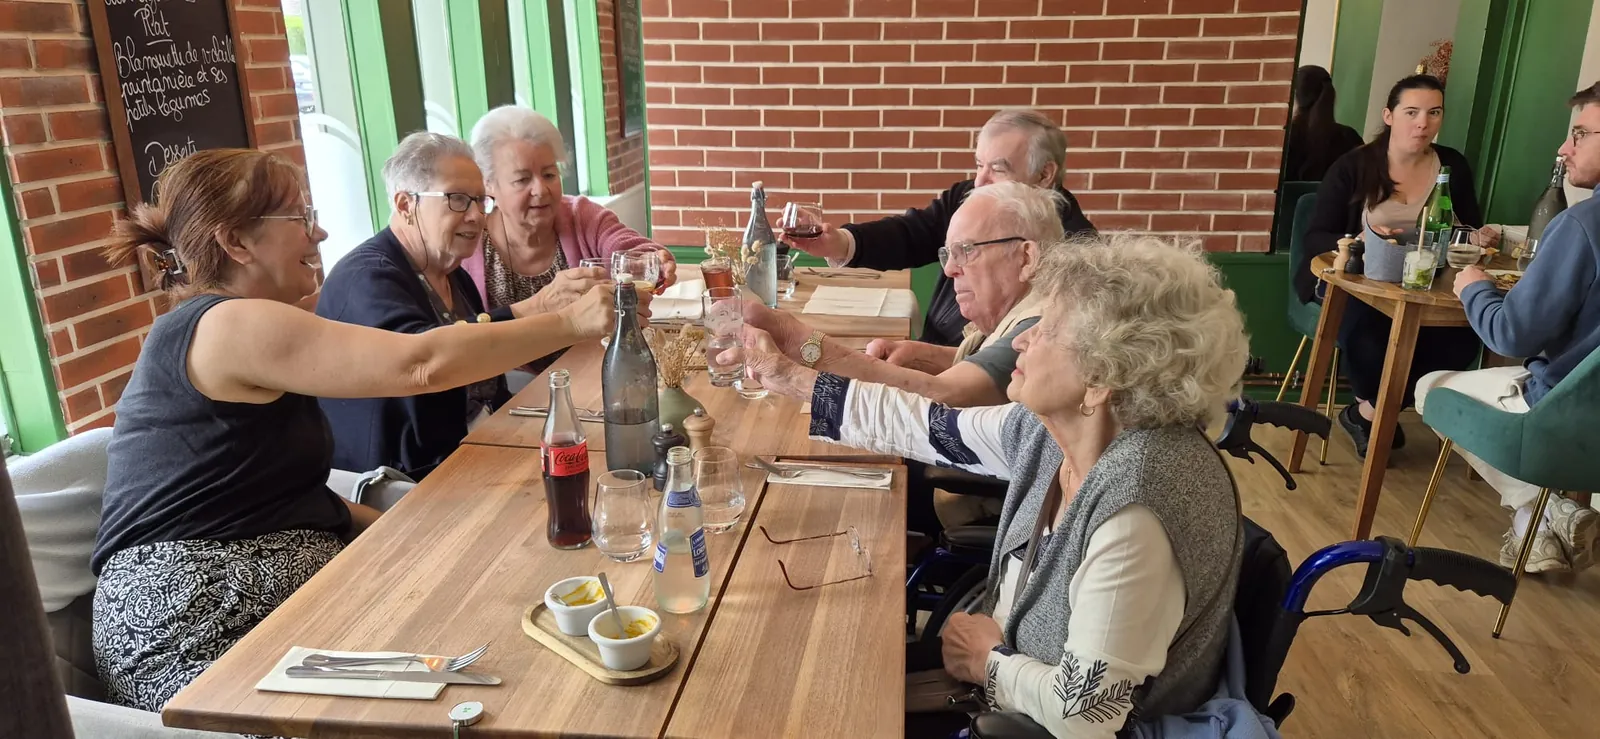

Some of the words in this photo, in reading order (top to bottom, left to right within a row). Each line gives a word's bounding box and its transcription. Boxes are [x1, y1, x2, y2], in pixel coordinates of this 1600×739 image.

[134, 4, 171, 37] Plat
[114, 36, 186, 78] Blanquette
[185, 41, 199, 63] de
[197, 65, 209, 83] et
[126, 95, 157, 133] petits
